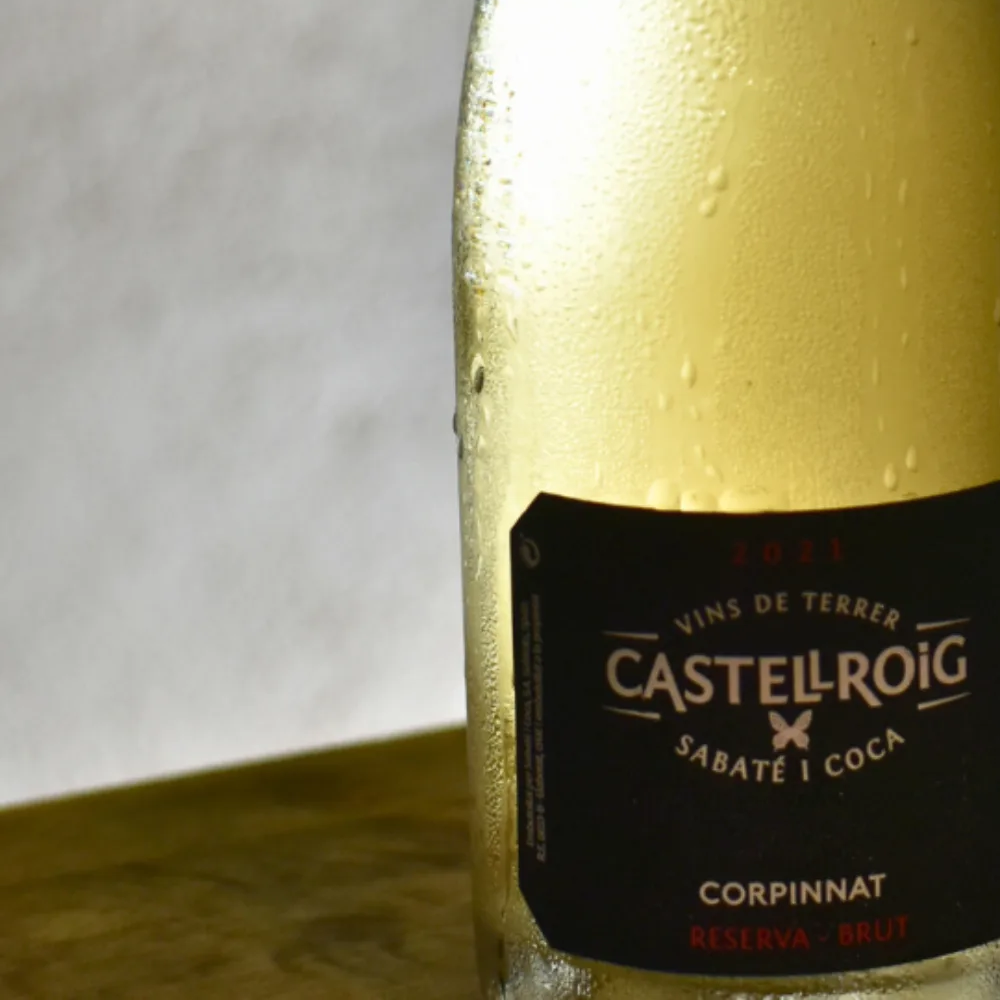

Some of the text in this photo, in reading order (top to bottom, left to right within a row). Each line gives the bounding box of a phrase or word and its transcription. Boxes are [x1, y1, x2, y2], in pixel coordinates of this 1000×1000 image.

[732, 537, 844, 565] 2021
[675, 591, 901, 636] VINS DE TERRER
[675, 727, 906, 784] SABATÉ I COCA
[699, 873, 887, 906] CORPINNAT
[690, 925, 810, 951] RESERVA
[839, 915, 910, 947] BRUT
